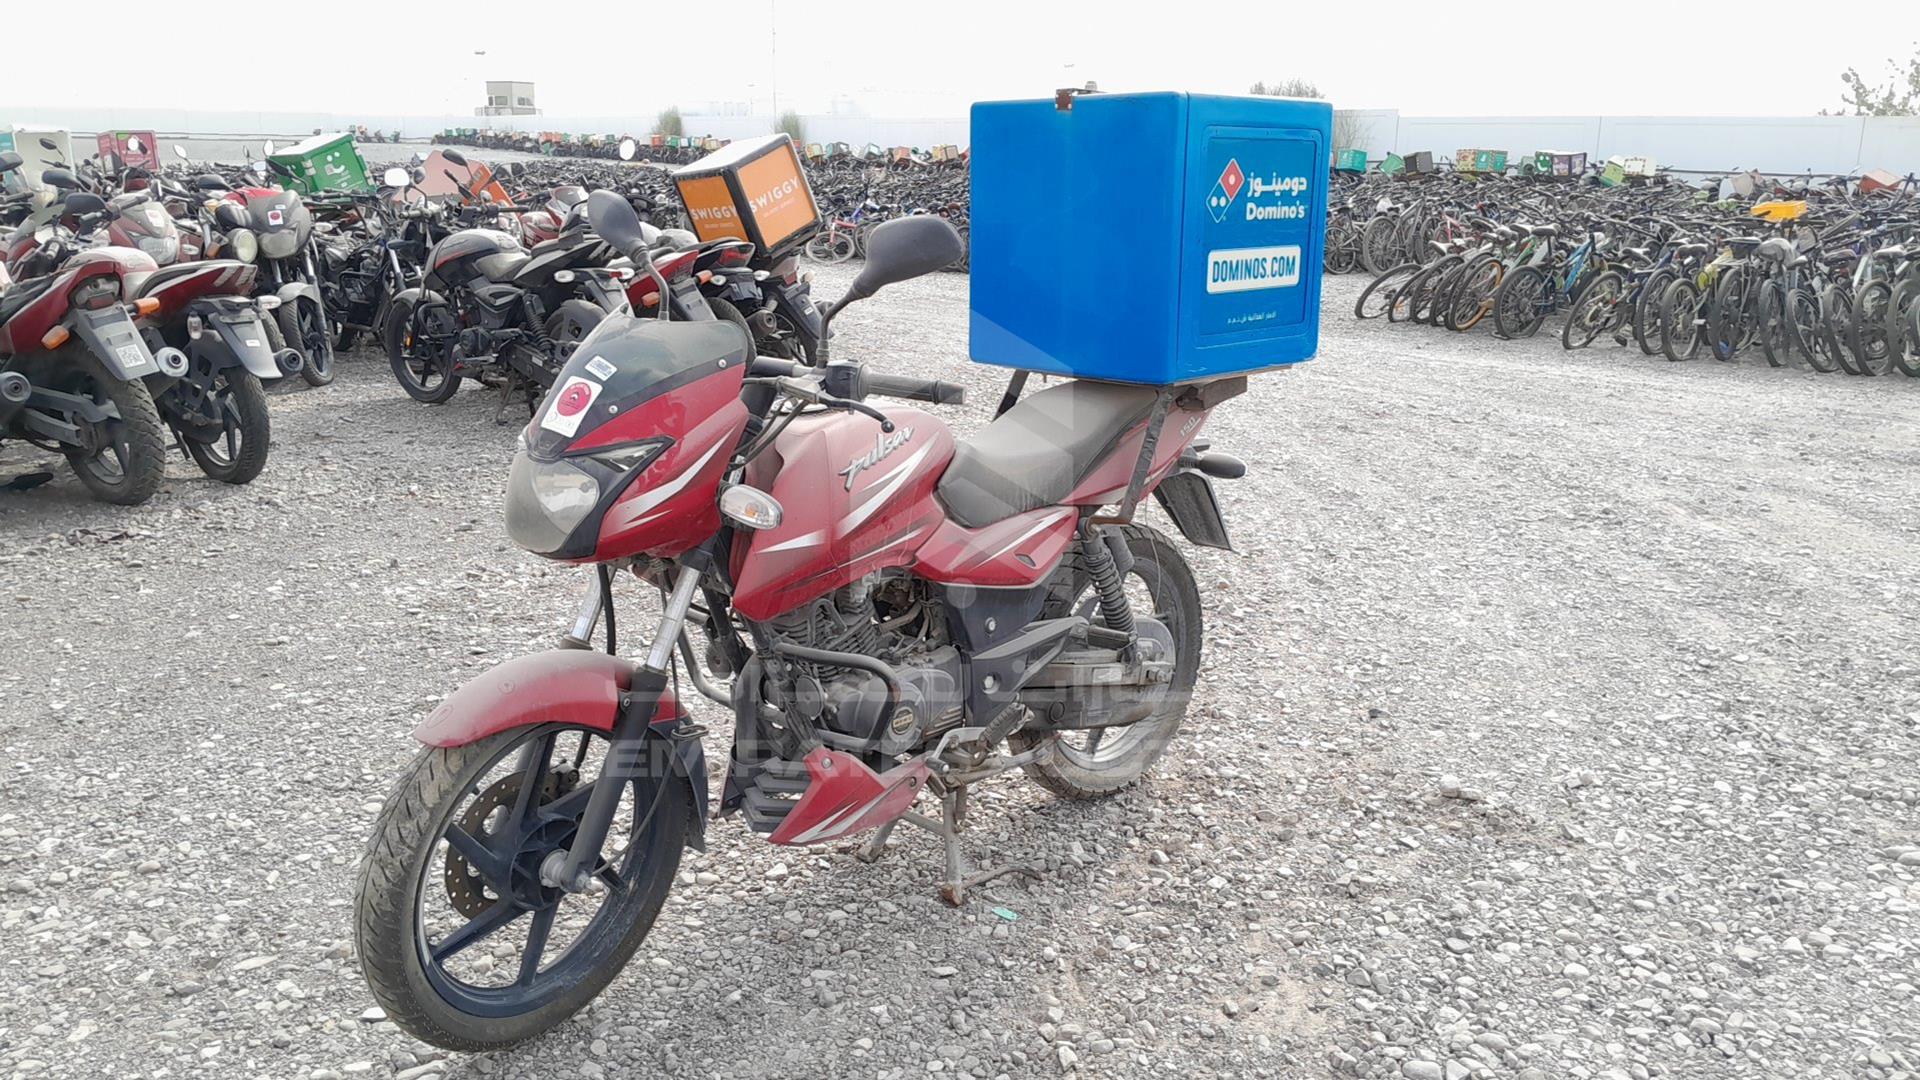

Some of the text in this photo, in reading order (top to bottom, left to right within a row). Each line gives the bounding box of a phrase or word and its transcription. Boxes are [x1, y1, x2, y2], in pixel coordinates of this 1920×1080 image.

[749, 175, 800, 214] SWIGGY
[690, 204, 738, 220] SWIGGY
[1246, 200, 1305, 220] Domino's
[1212, 255, 1296, 283] DOMINOS.COM
